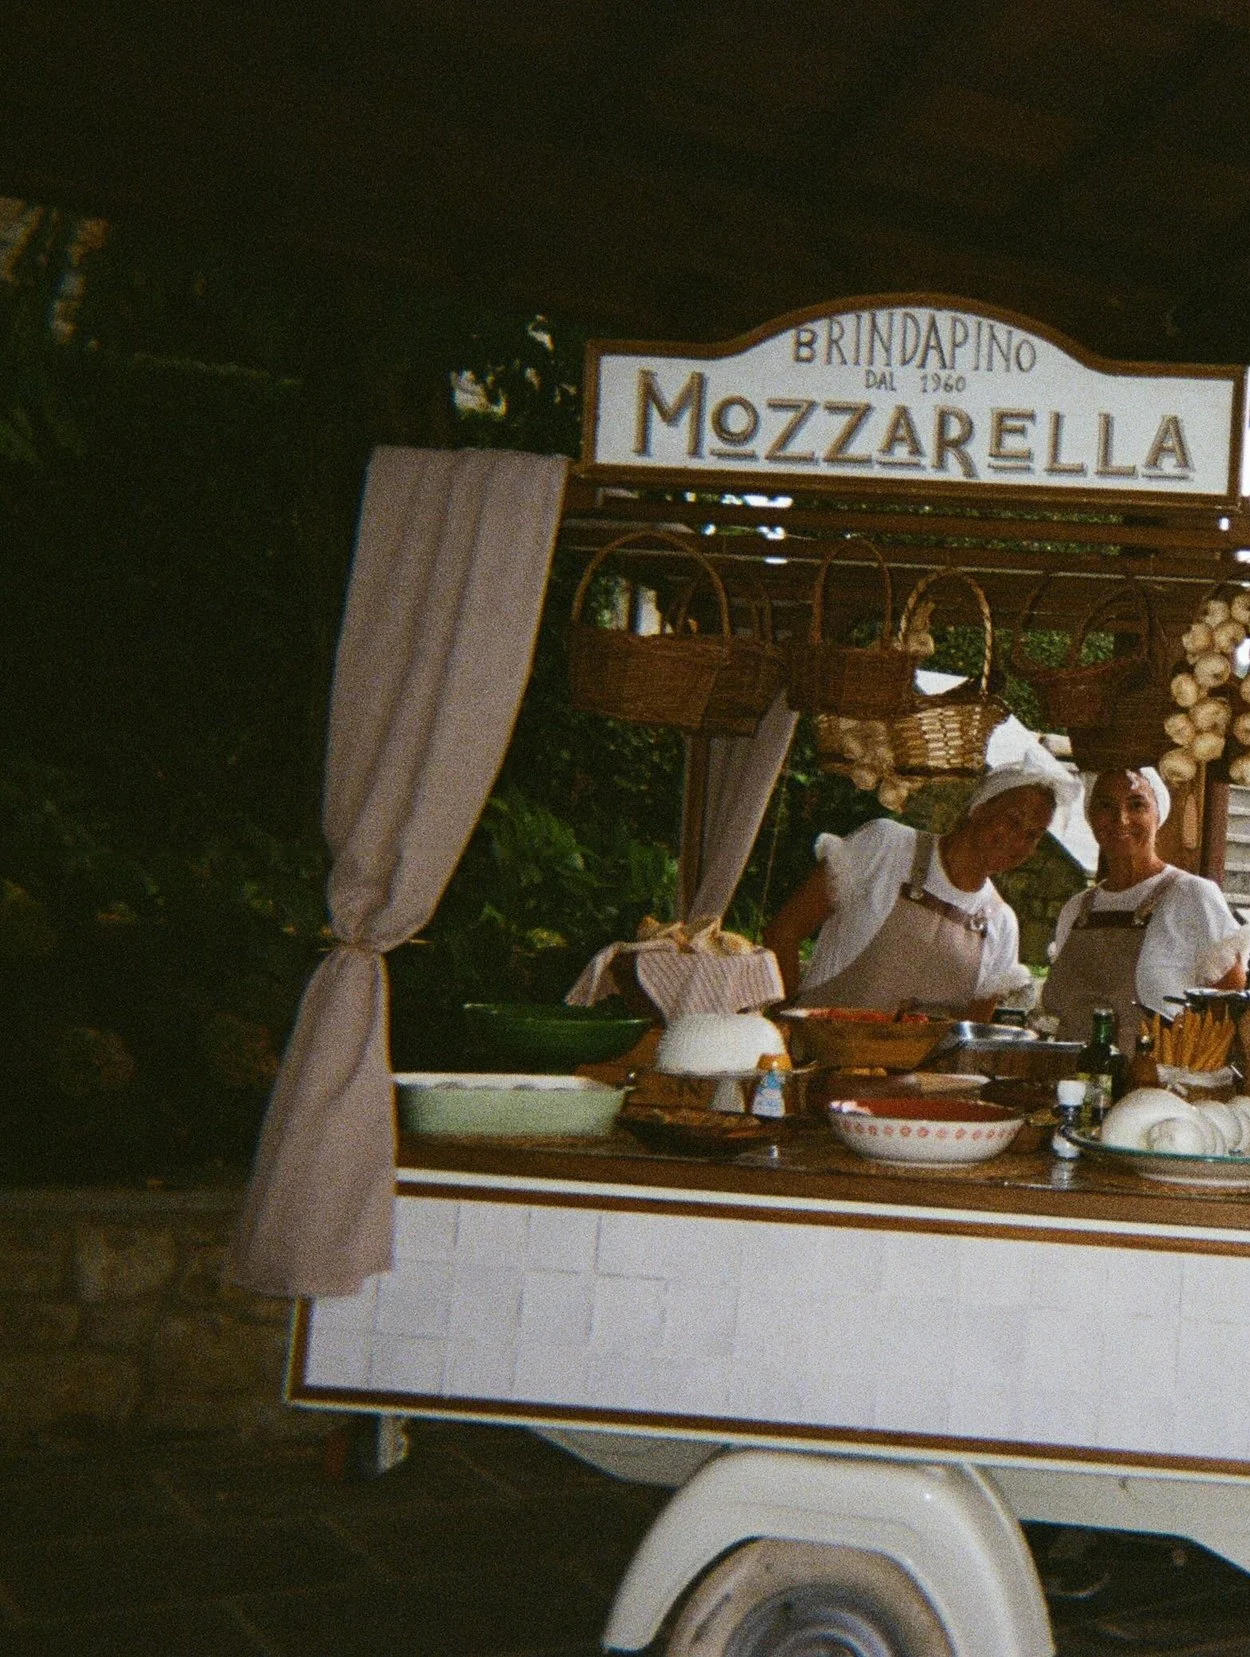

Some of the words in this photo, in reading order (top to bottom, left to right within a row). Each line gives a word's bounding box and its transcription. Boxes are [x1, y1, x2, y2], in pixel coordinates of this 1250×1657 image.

[791, 310, 1037, 373] BRINDAPINO
[864, 369, 897, 392] DAL
[919, 372, 967, 394] 1960
[632, 368, 1195, 479] MOZZARELLA
